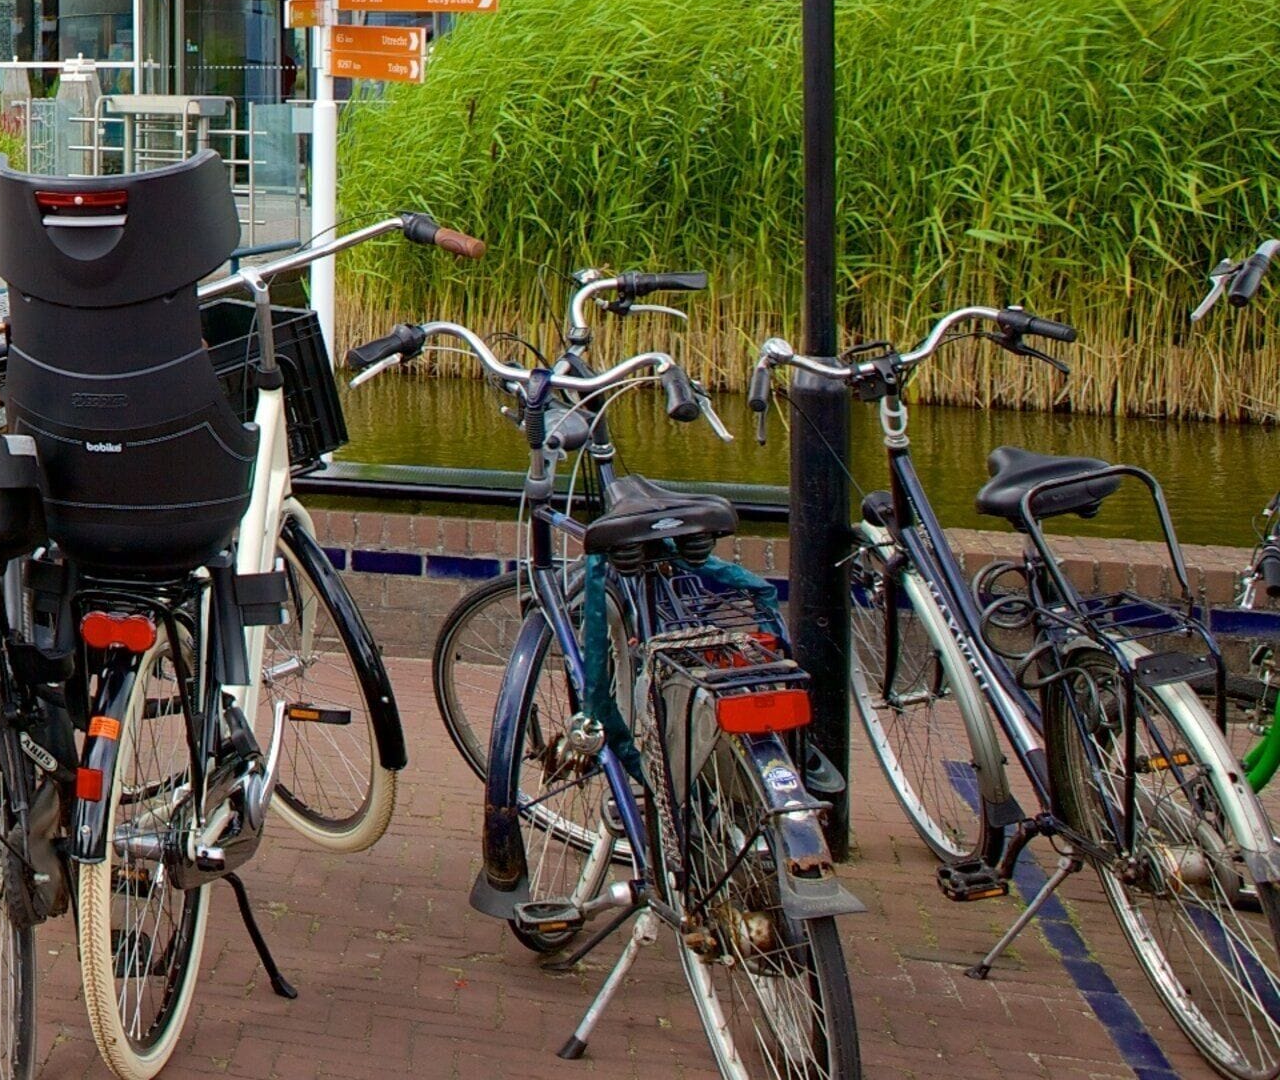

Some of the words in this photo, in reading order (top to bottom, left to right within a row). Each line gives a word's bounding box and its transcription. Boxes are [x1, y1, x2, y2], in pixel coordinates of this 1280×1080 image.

[382, 35, 407, 46] Utrecht
[85, 441, 122, 453] bobike
[926, 580, 990, 691] MAXWELL
